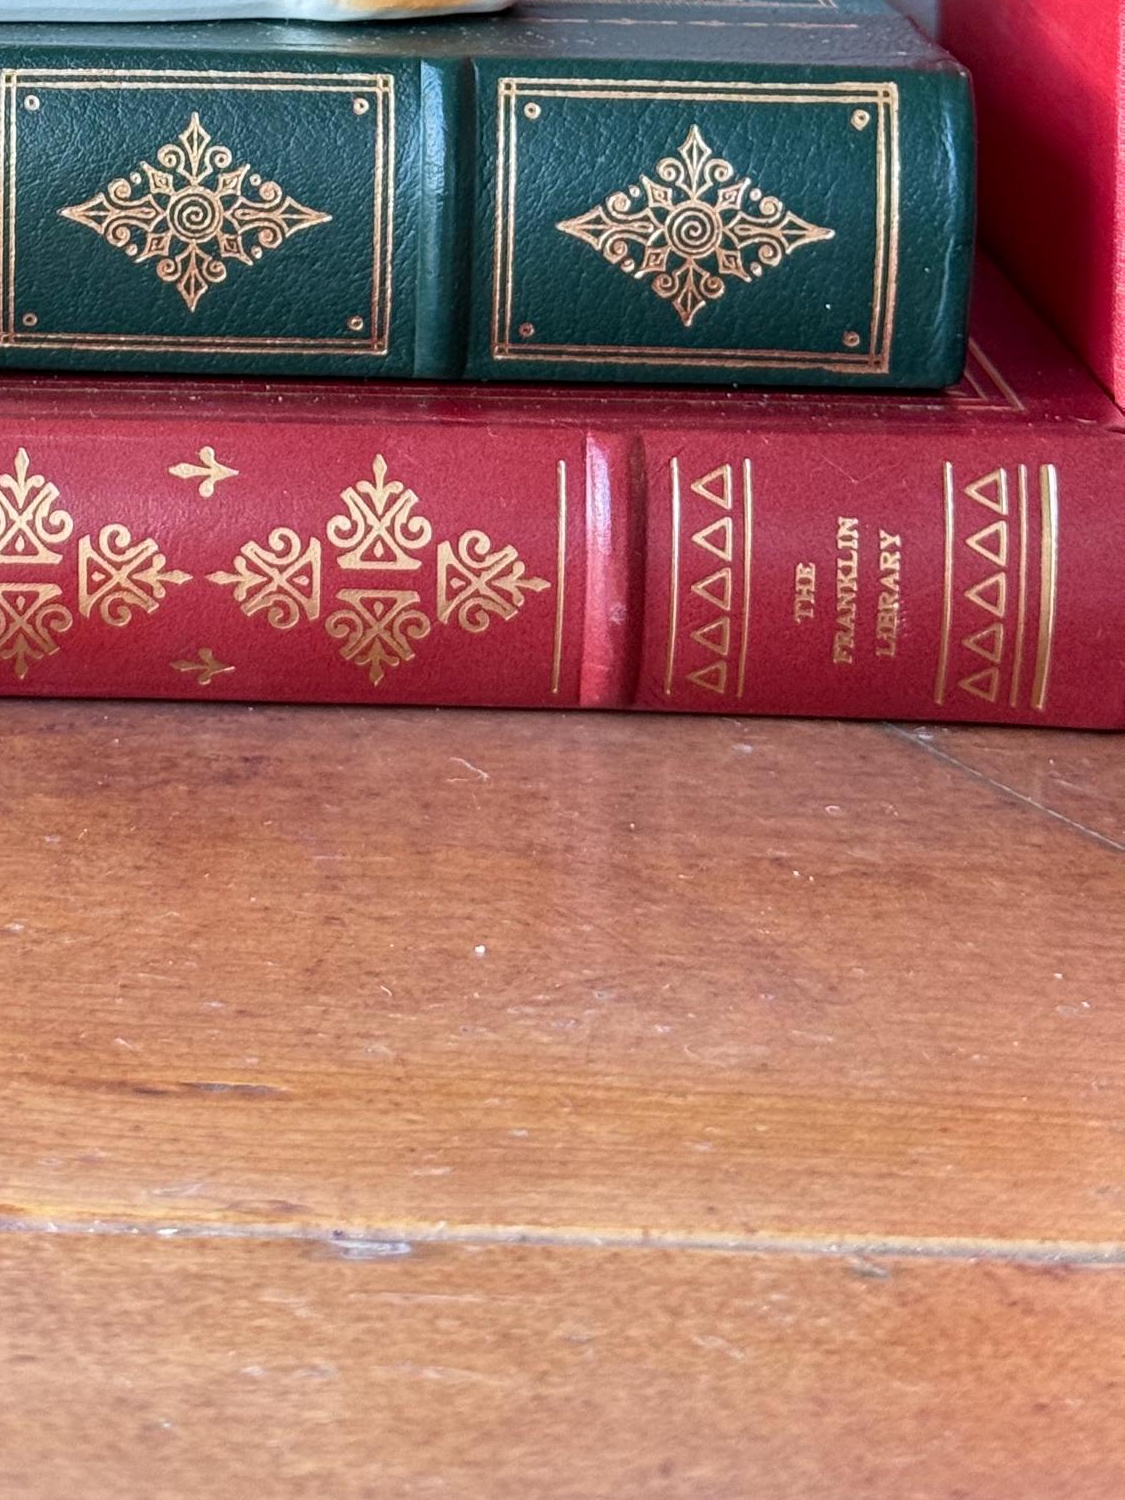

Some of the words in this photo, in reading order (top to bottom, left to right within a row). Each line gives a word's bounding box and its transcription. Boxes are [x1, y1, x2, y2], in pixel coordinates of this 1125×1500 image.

[794, 562, 816, 623] THE
[833, 516, 859, 664] FRANKLIN
[876, 529, 901, 657] LIBRARY
